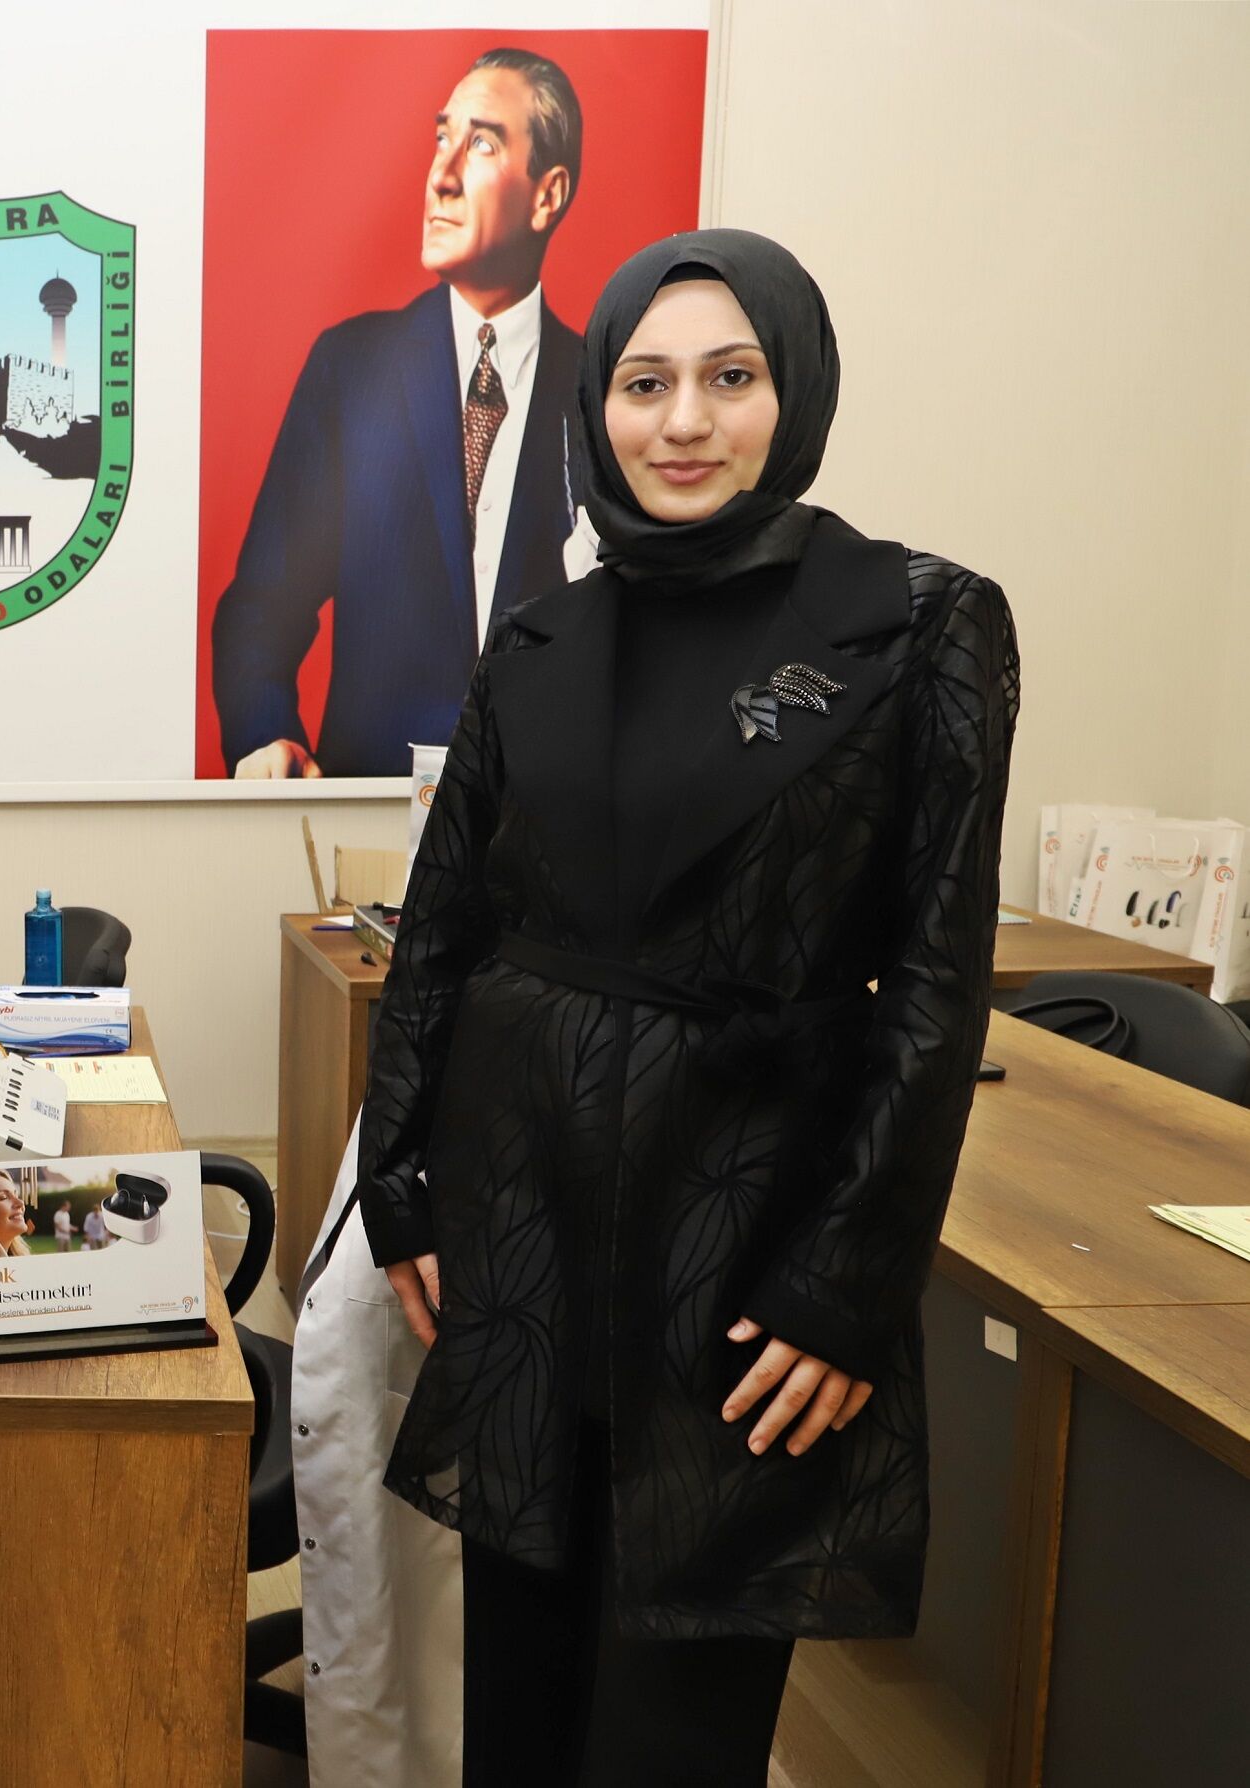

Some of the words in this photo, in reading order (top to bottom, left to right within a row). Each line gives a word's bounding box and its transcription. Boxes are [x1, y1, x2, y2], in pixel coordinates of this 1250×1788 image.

[24, 464, 128, 605] ODALARI
[105, 251, 131, 418] BİRLİĞİ
[26, 1306, 56, 1316] Yeniden
